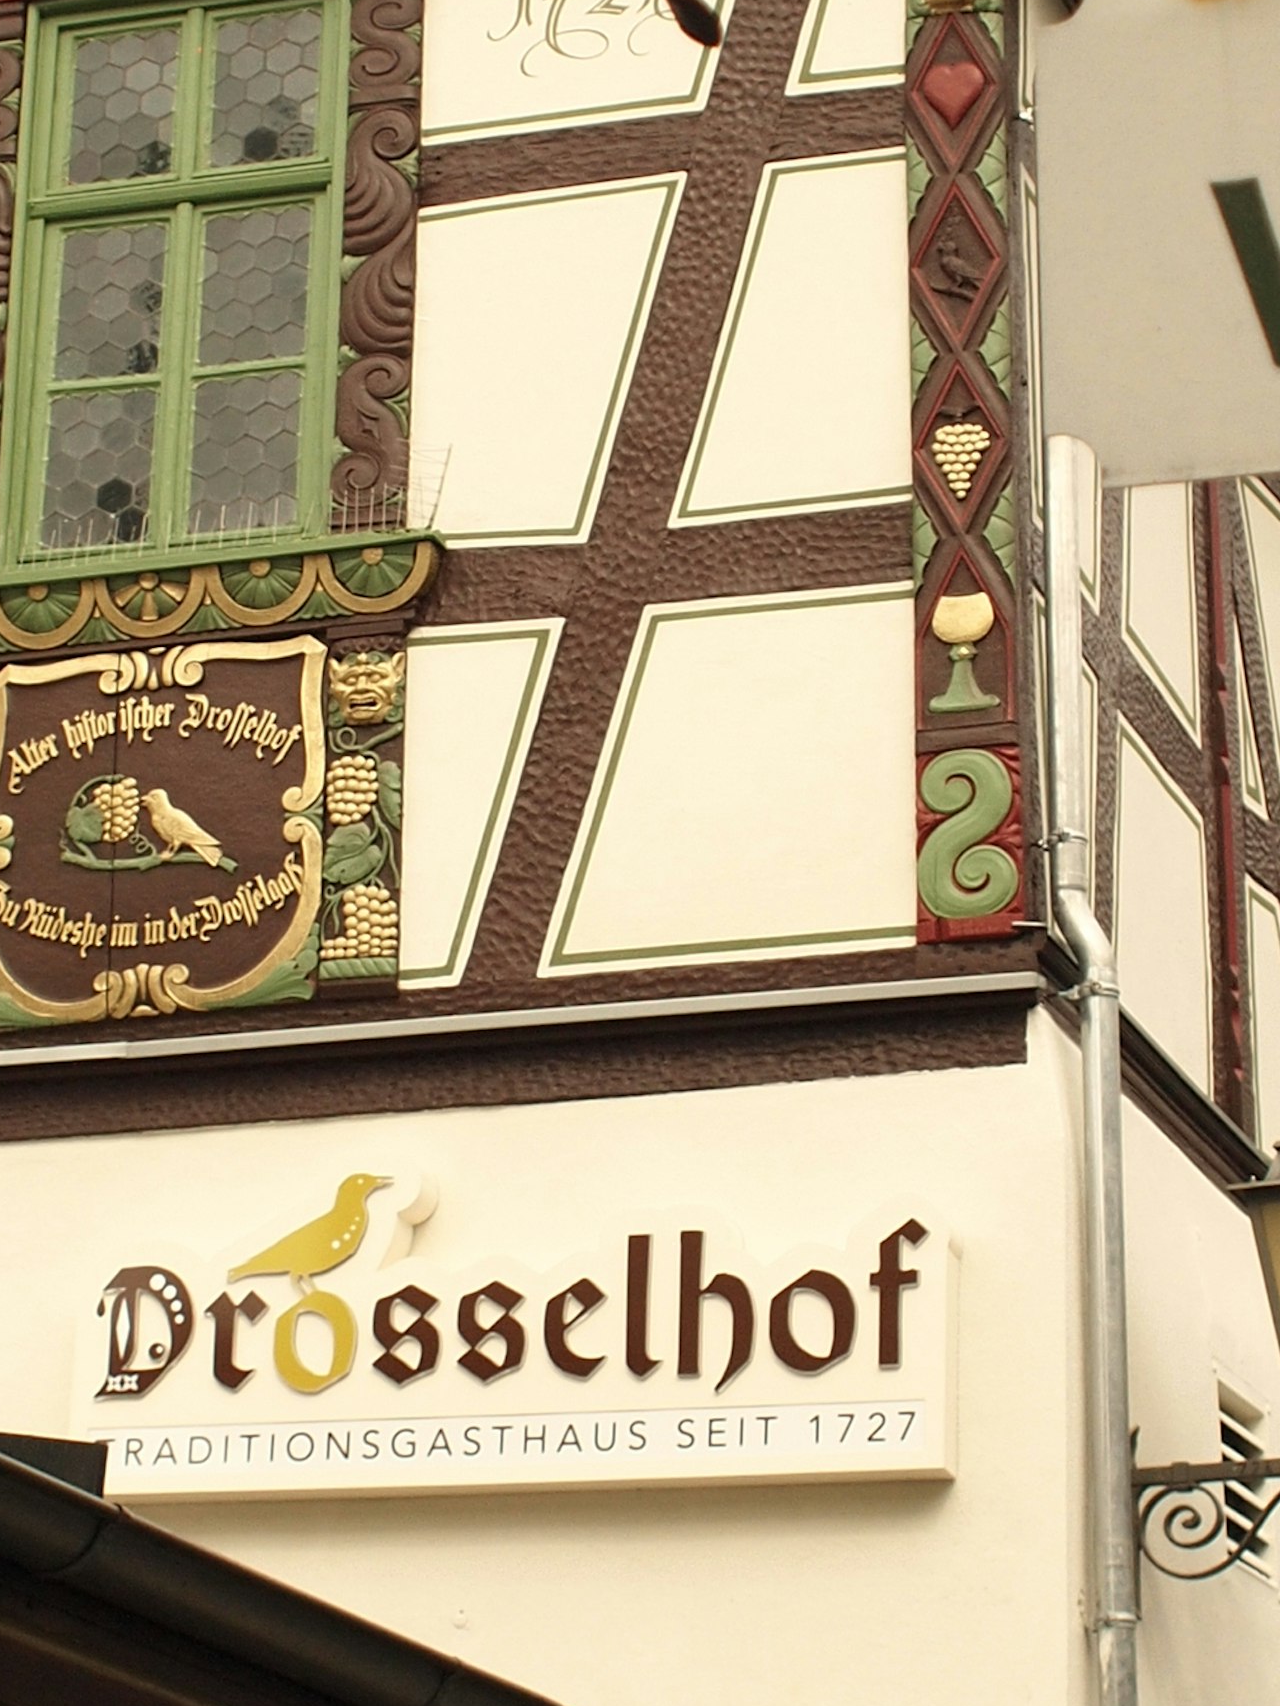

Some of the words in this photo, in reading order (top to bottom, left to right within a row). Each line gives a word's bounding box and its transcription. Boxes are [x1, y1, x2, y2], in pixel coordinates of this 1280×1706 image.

[7, 732, 60, 794] Alter
[143, 912, 167, 946] in
[167, 907, 202, 943] der
[93, 1217, 929, 1402] Drosselhof
[676, 1415, 779, 1449] SEIT
[808, 1410, 917, 1445] 1727
